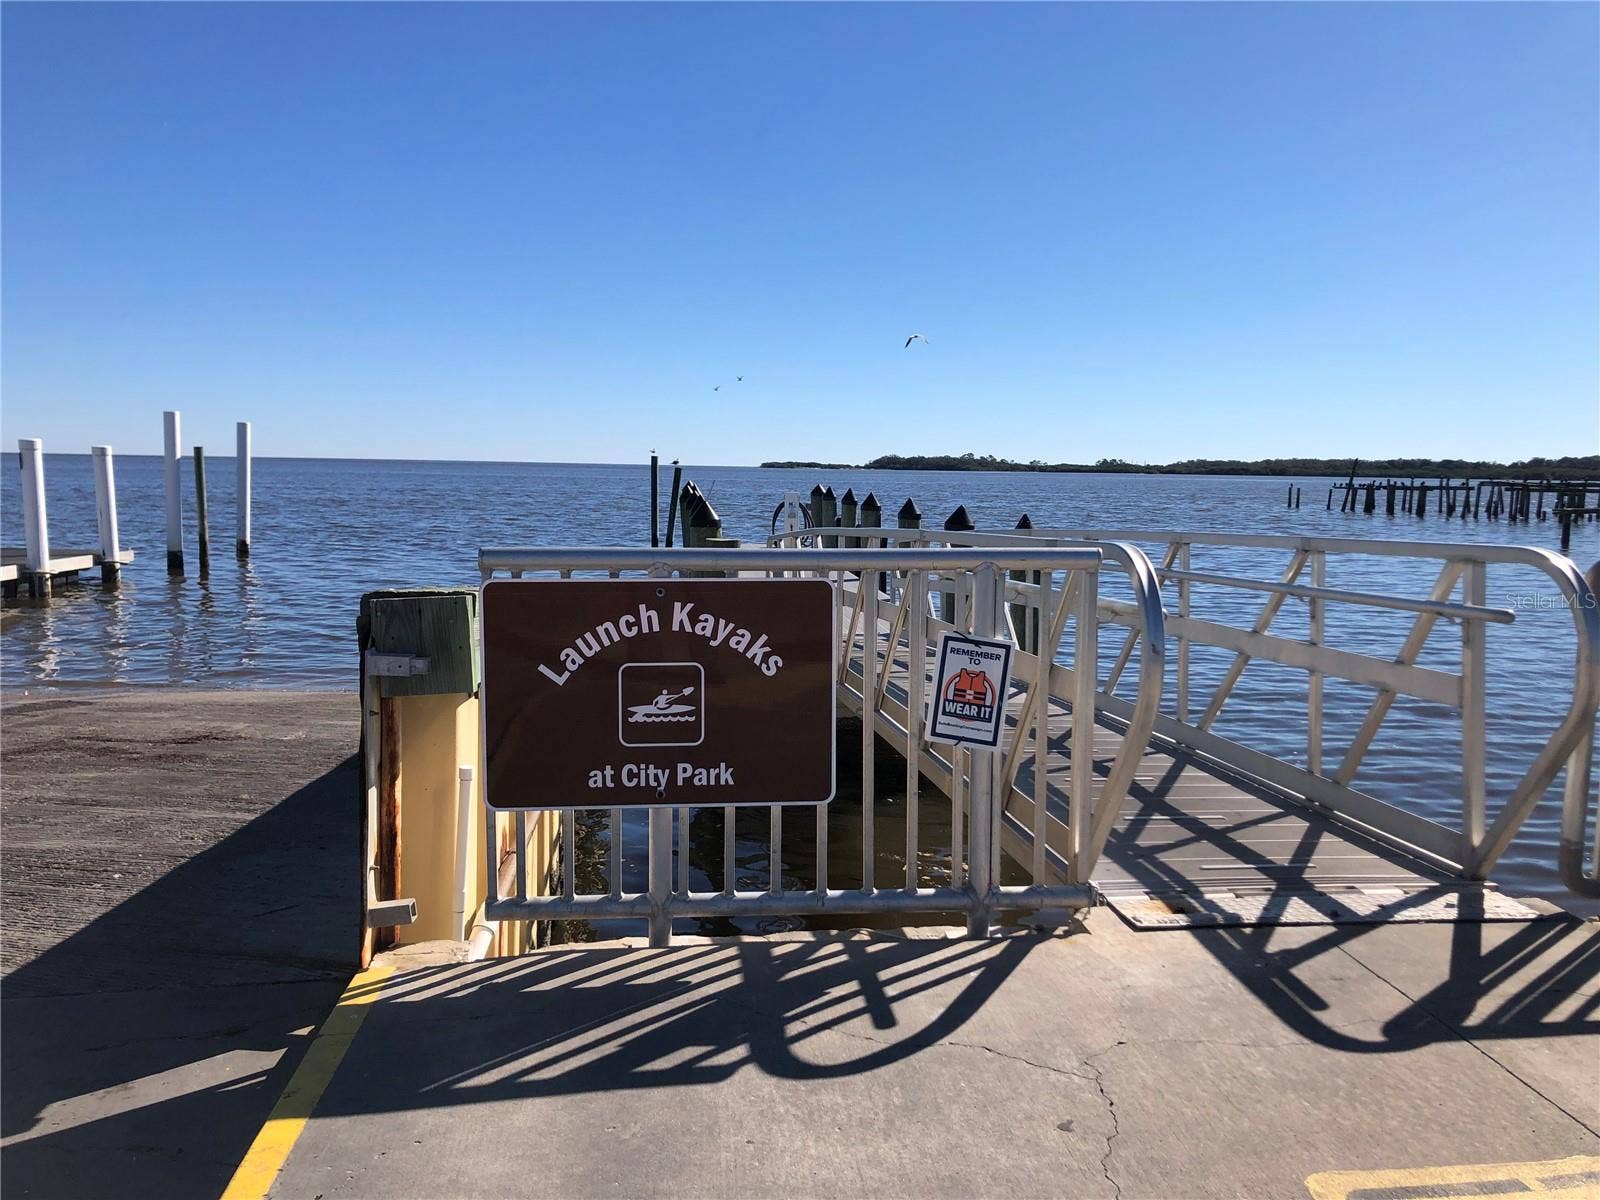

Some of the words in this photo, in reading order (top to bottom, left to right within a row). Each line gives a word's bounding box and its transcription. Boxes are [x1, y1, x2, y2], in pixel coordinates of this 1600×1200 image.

[537, 603, 660, 686] Launch
[672, 601, 784, 677] Kayaks
[950, 647, 1001, 661] REMEMBER
[968, 657, 981, 665] TO
[945, 701, 978, 717] WEAR
[981, 707, 991, 718] IT
[588, 765, 615, 788] at
[621, 764, 670, 790] City
[676, 762, 735, 786] Park
